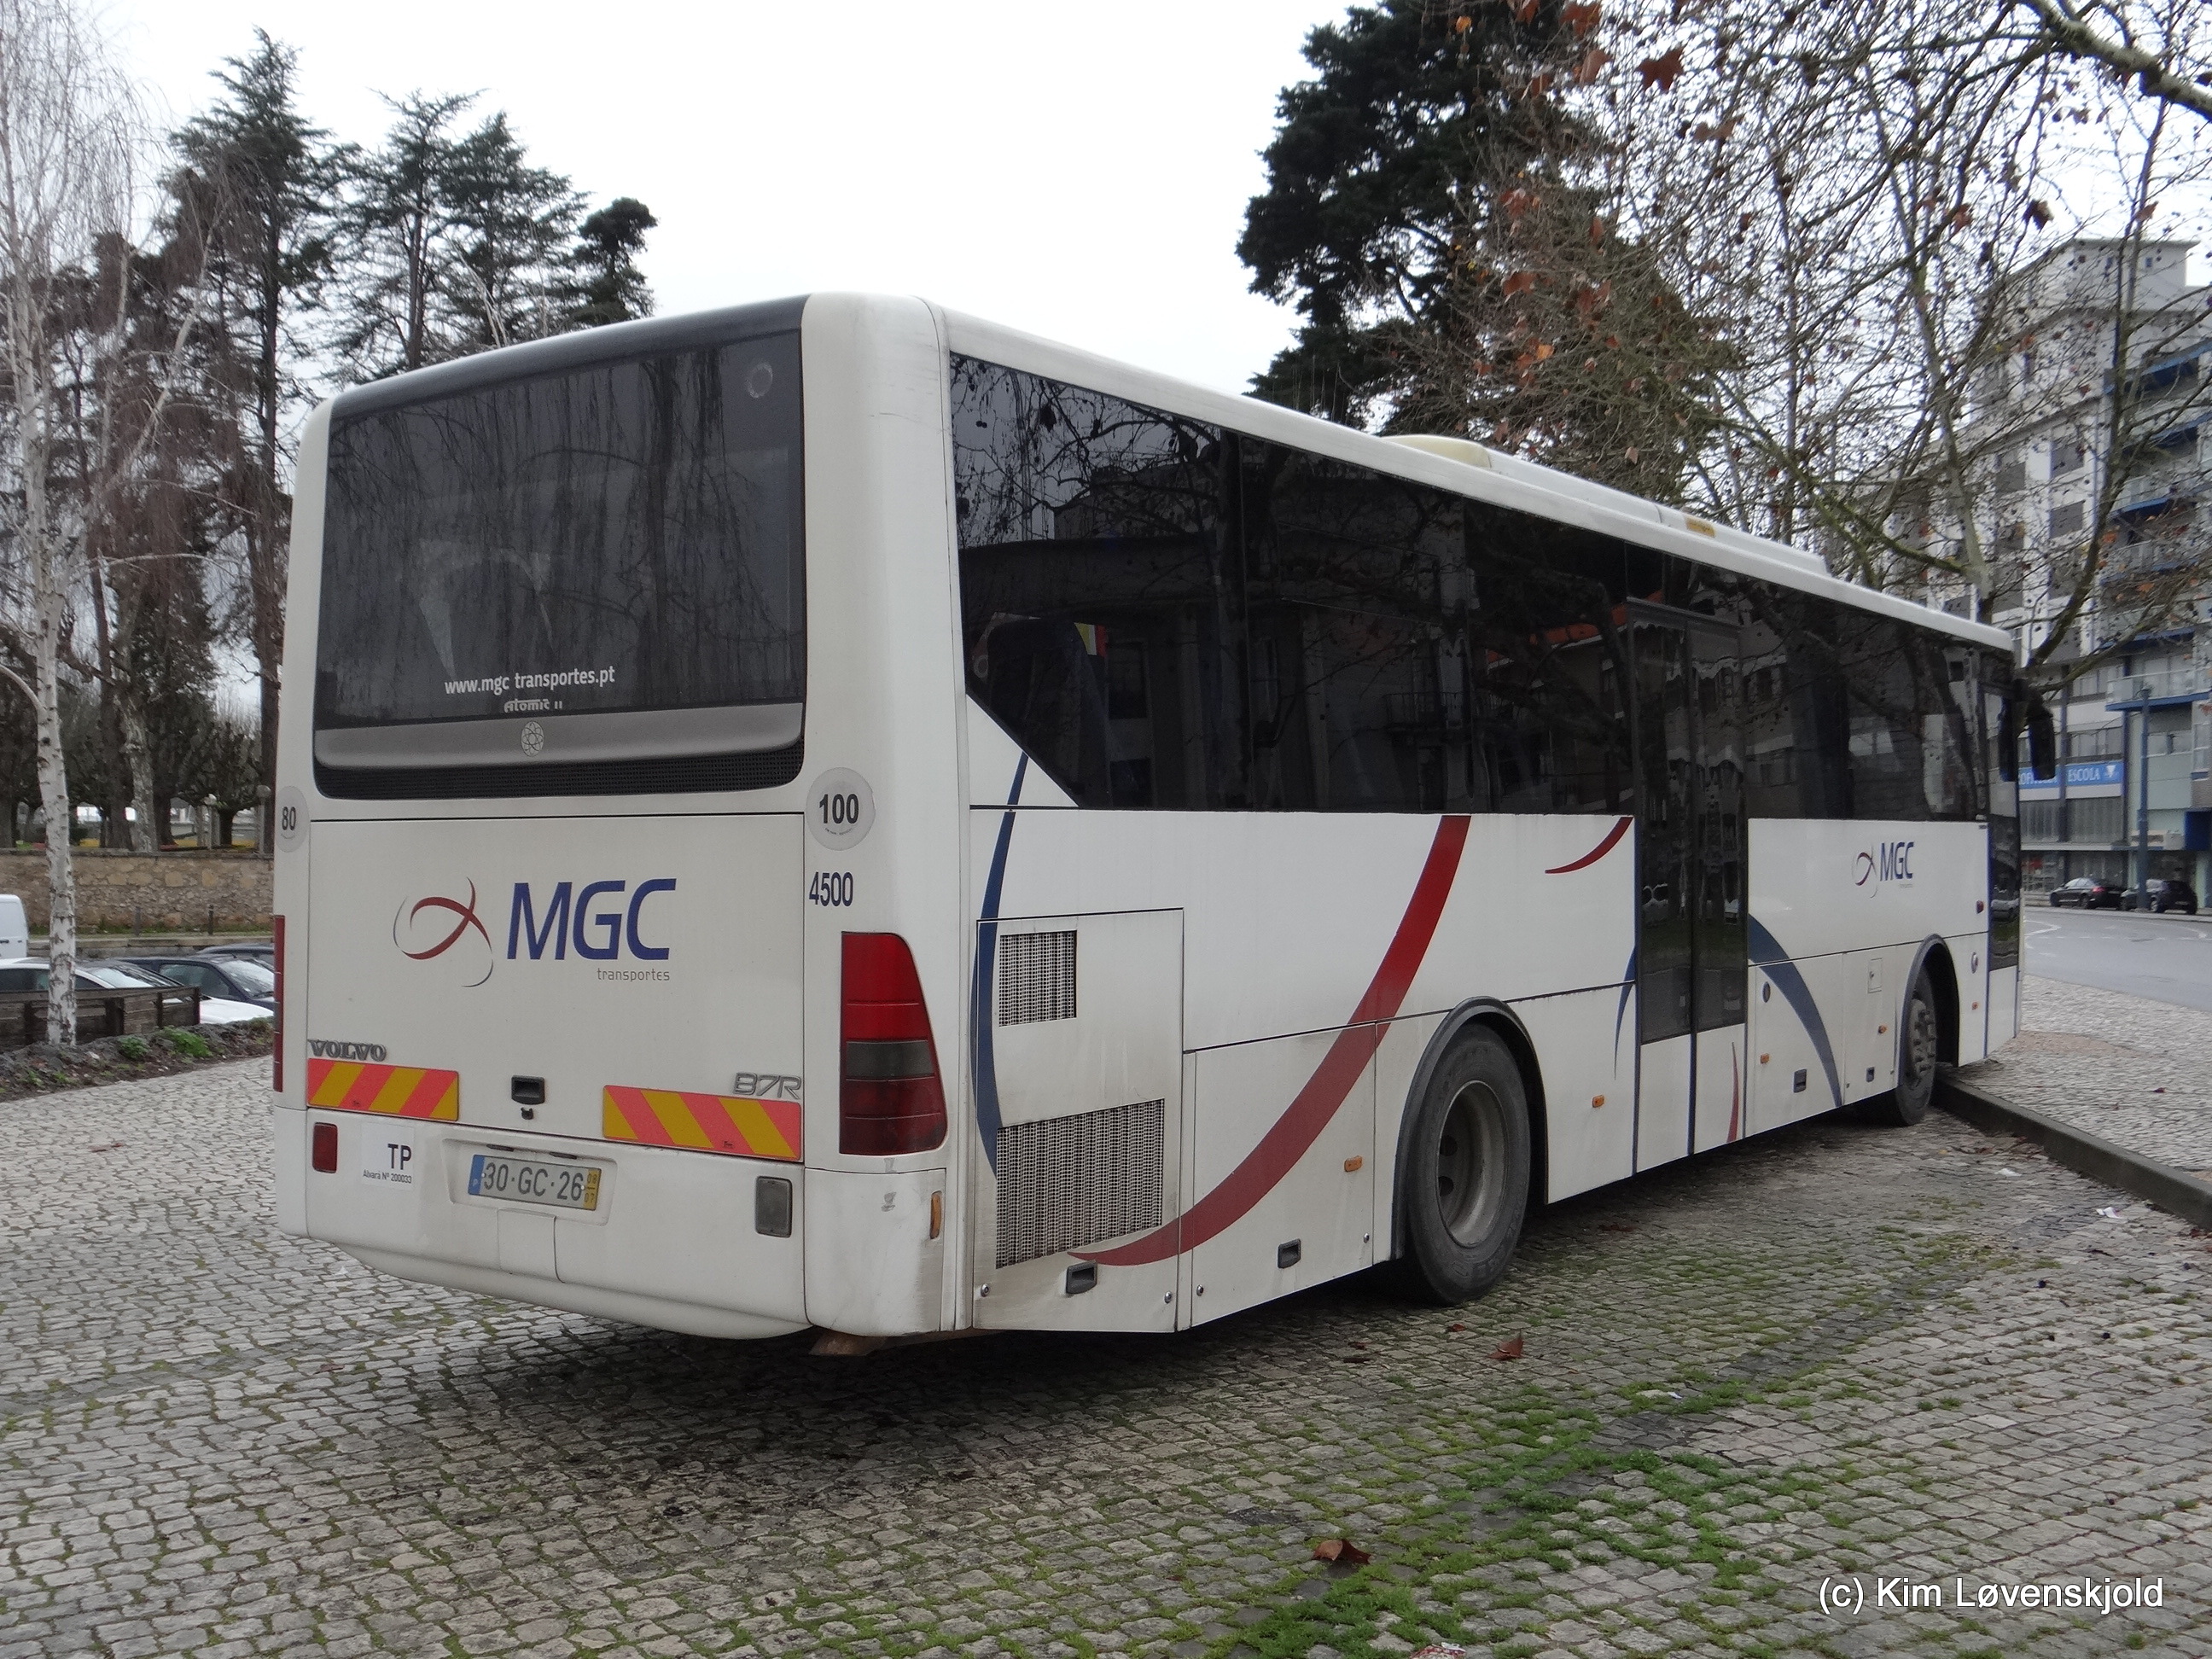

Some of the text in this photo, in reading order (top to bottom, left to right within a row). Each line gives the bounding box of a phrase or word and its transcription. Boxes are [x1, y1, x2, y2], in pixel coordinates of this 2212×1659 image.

[445, 666, 615, 696] www.mgc transportes.pt
[2068, 767, 2100, 783] ESCOLA
[282, 806, 296, 831] 80
[818, 793, 859, 824] 100
[1879, 841, 1914, 882] MGC
[808, 871, 854, 907] 4500
[506, 877, 678, 961] MGC
[597, 967, 671, 983] transportes
[307, 1039, 387, 1062] VOLVO
[733, 1072, 802, 1100] B7R
[387, 1143, 412, 1171] TP
